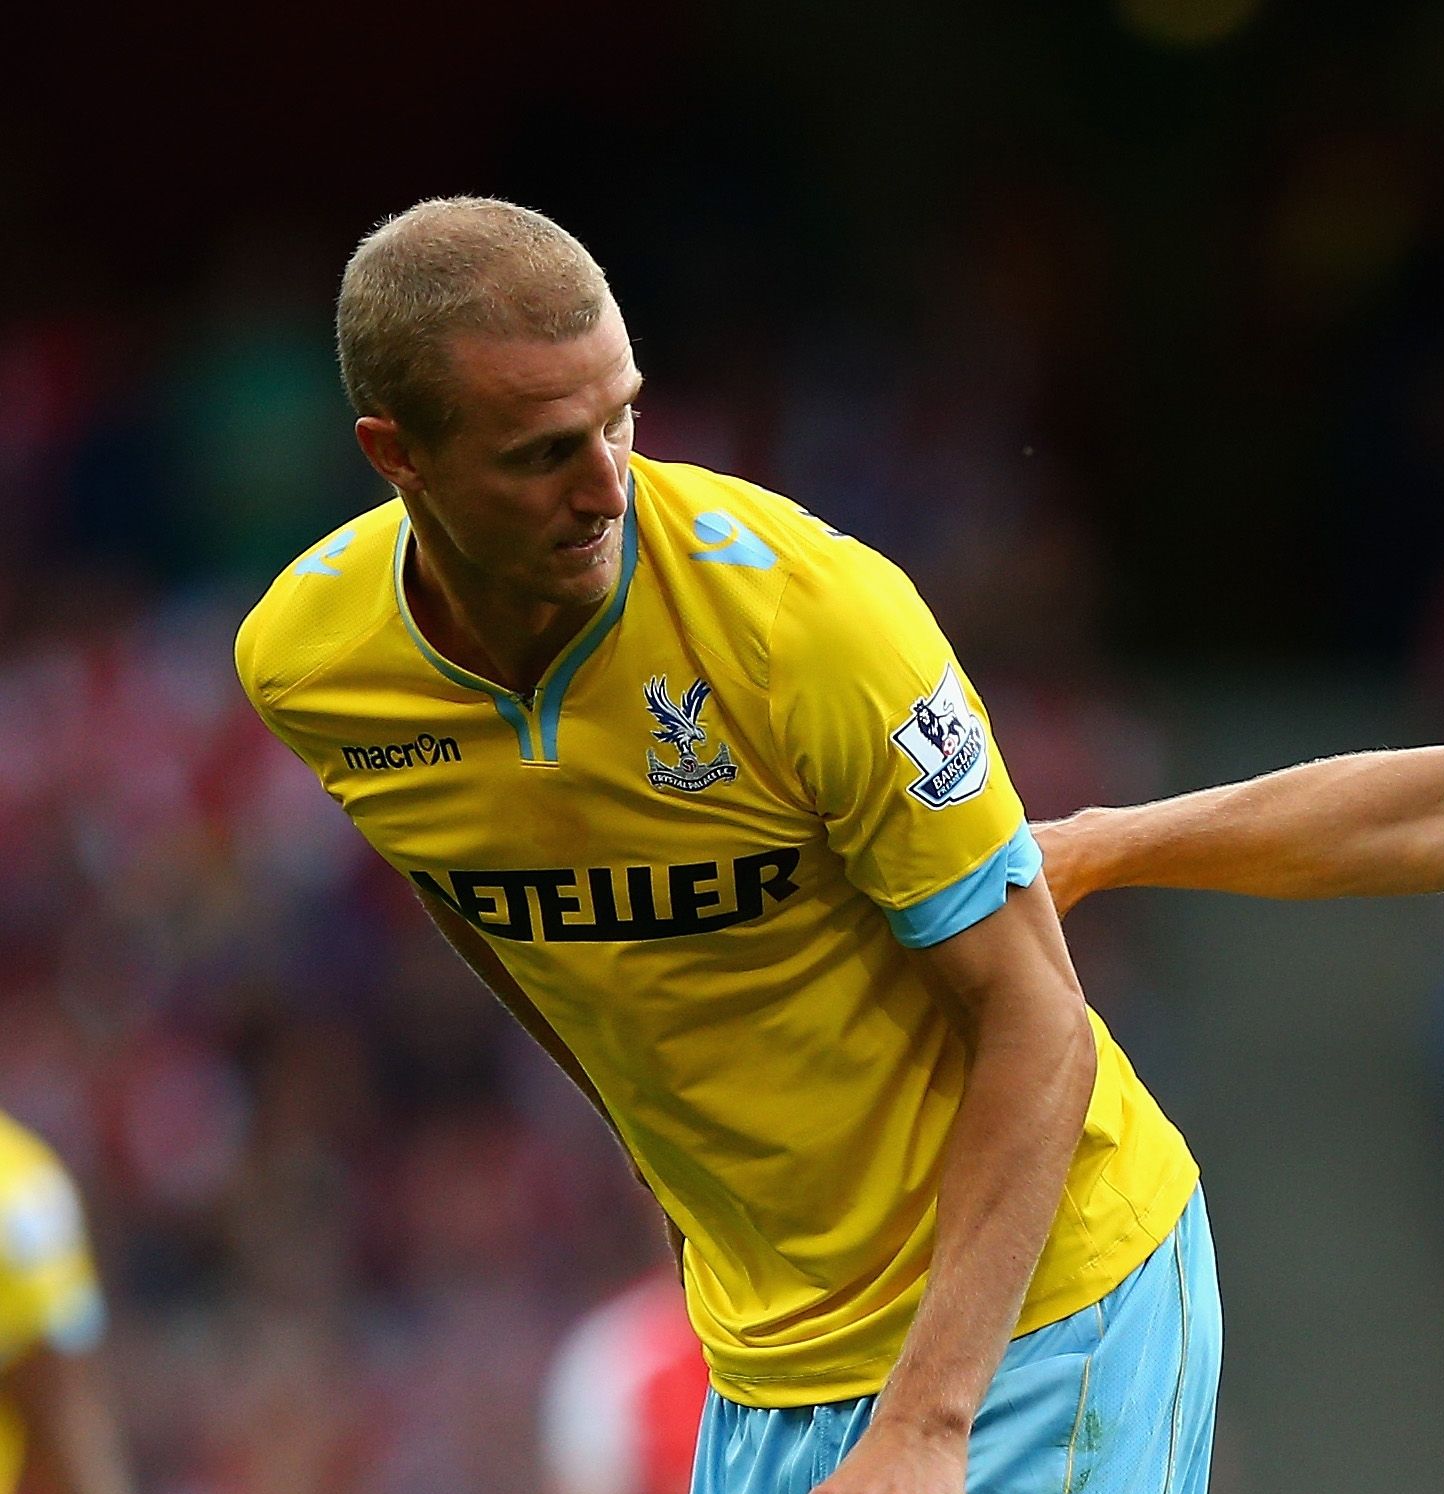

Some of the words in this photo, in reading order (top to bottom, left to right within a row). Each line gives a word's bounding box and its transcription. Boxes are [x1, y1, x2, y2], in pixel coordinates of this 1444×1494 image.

[342, 733, 462, 769] macron
[652, 773, 688, 789] CRYSTAL
[688, 772, 717, 789] PALACE
